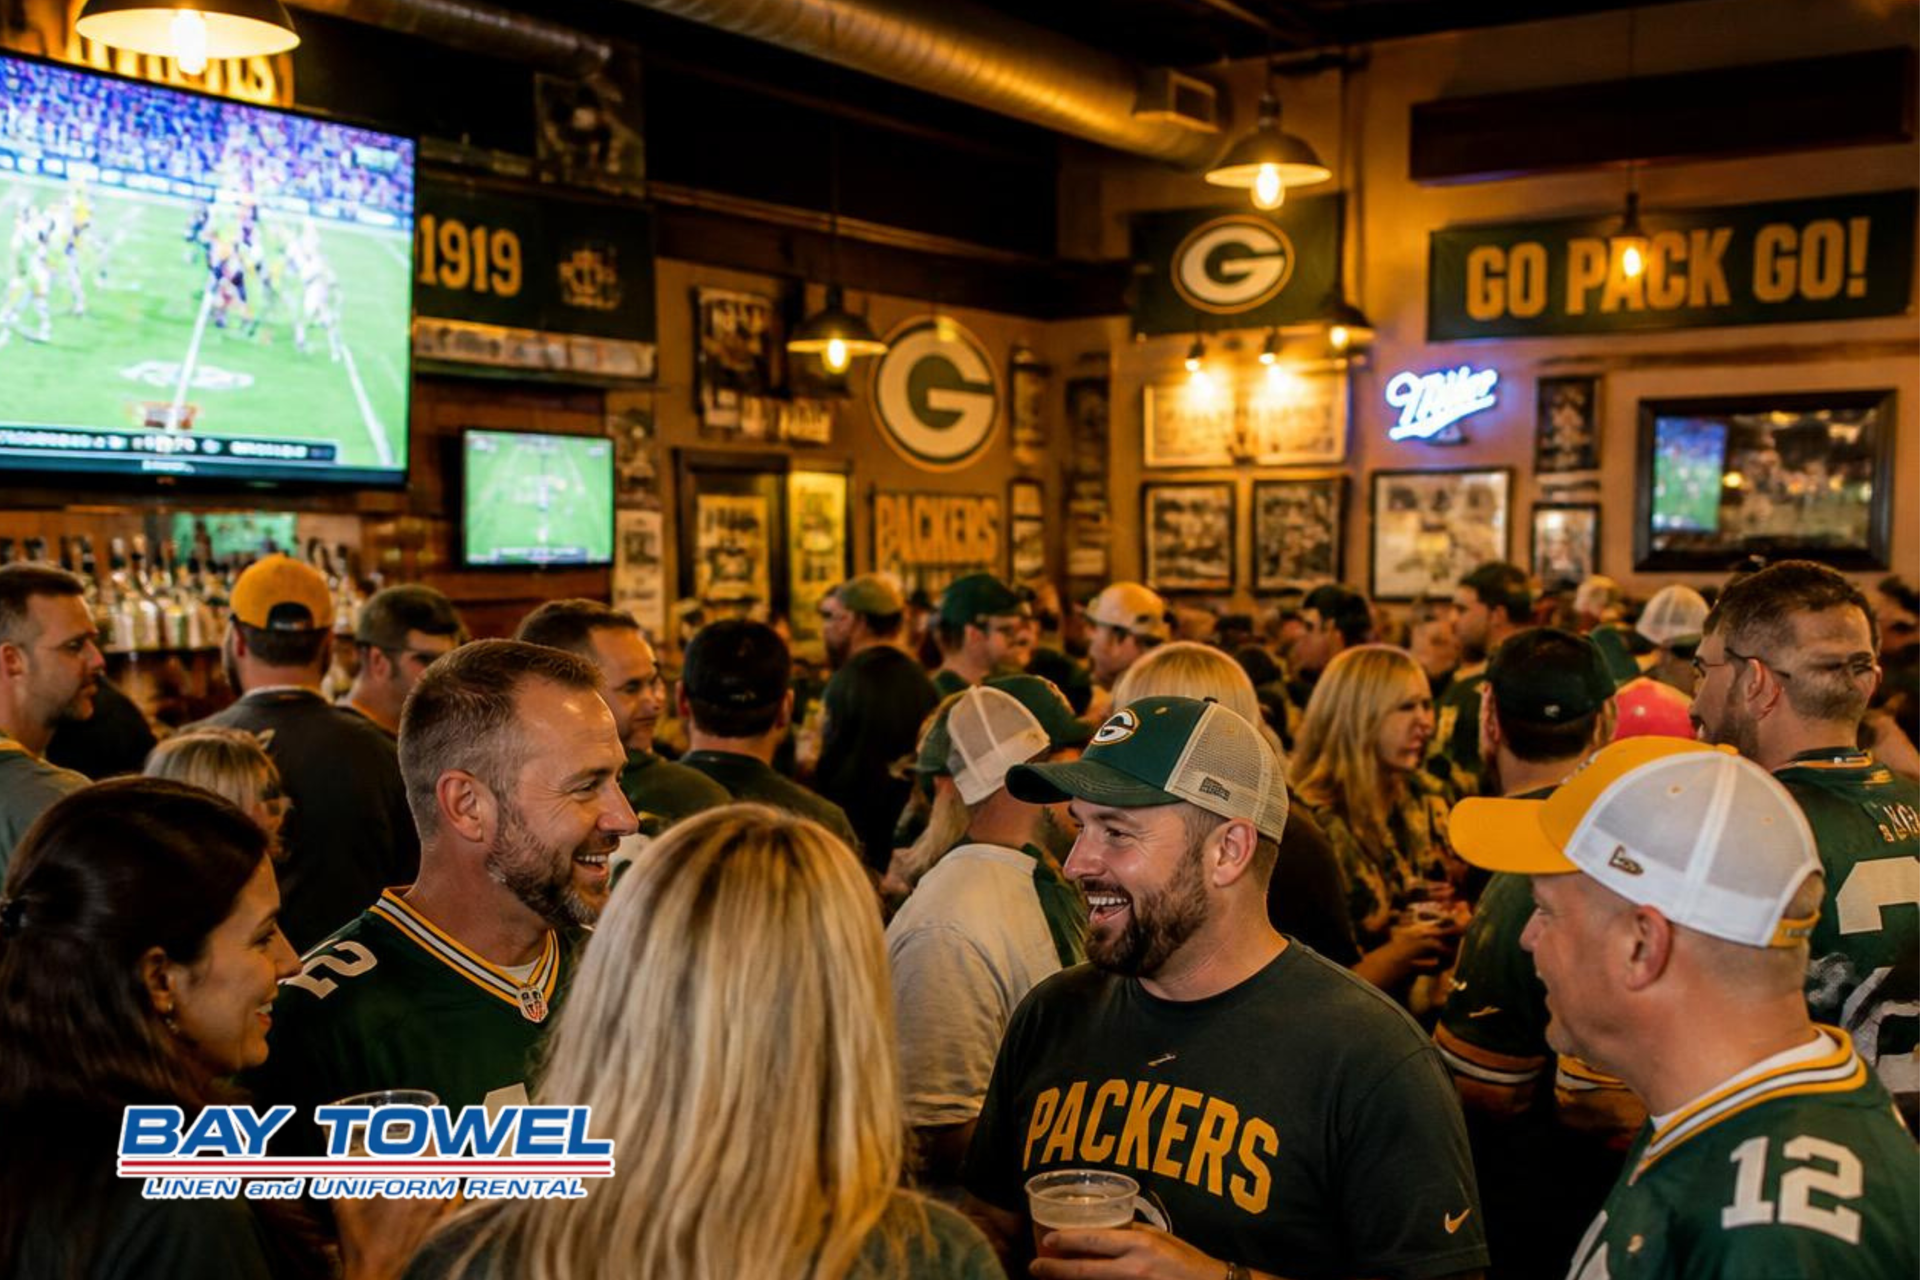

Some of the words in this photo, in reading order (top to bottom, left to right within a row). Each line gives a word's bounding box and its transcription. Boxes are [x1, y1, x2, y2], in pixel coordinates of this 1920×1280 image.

[419, 213, 522, 298] 1919
[1180, 224, 1286, 304] G
[1466, 243, 1548, 322] GO
[1565, 228, 1733, 317] PACK
[1753, 216, 1872, 303] GO!
[878, 330, 996, 459] G
[876, 495, 999, 563] PACKERS
[1022, 1078, 1280, 1215] PACKERS
[1721, 1134, 1864, 1245] 12
